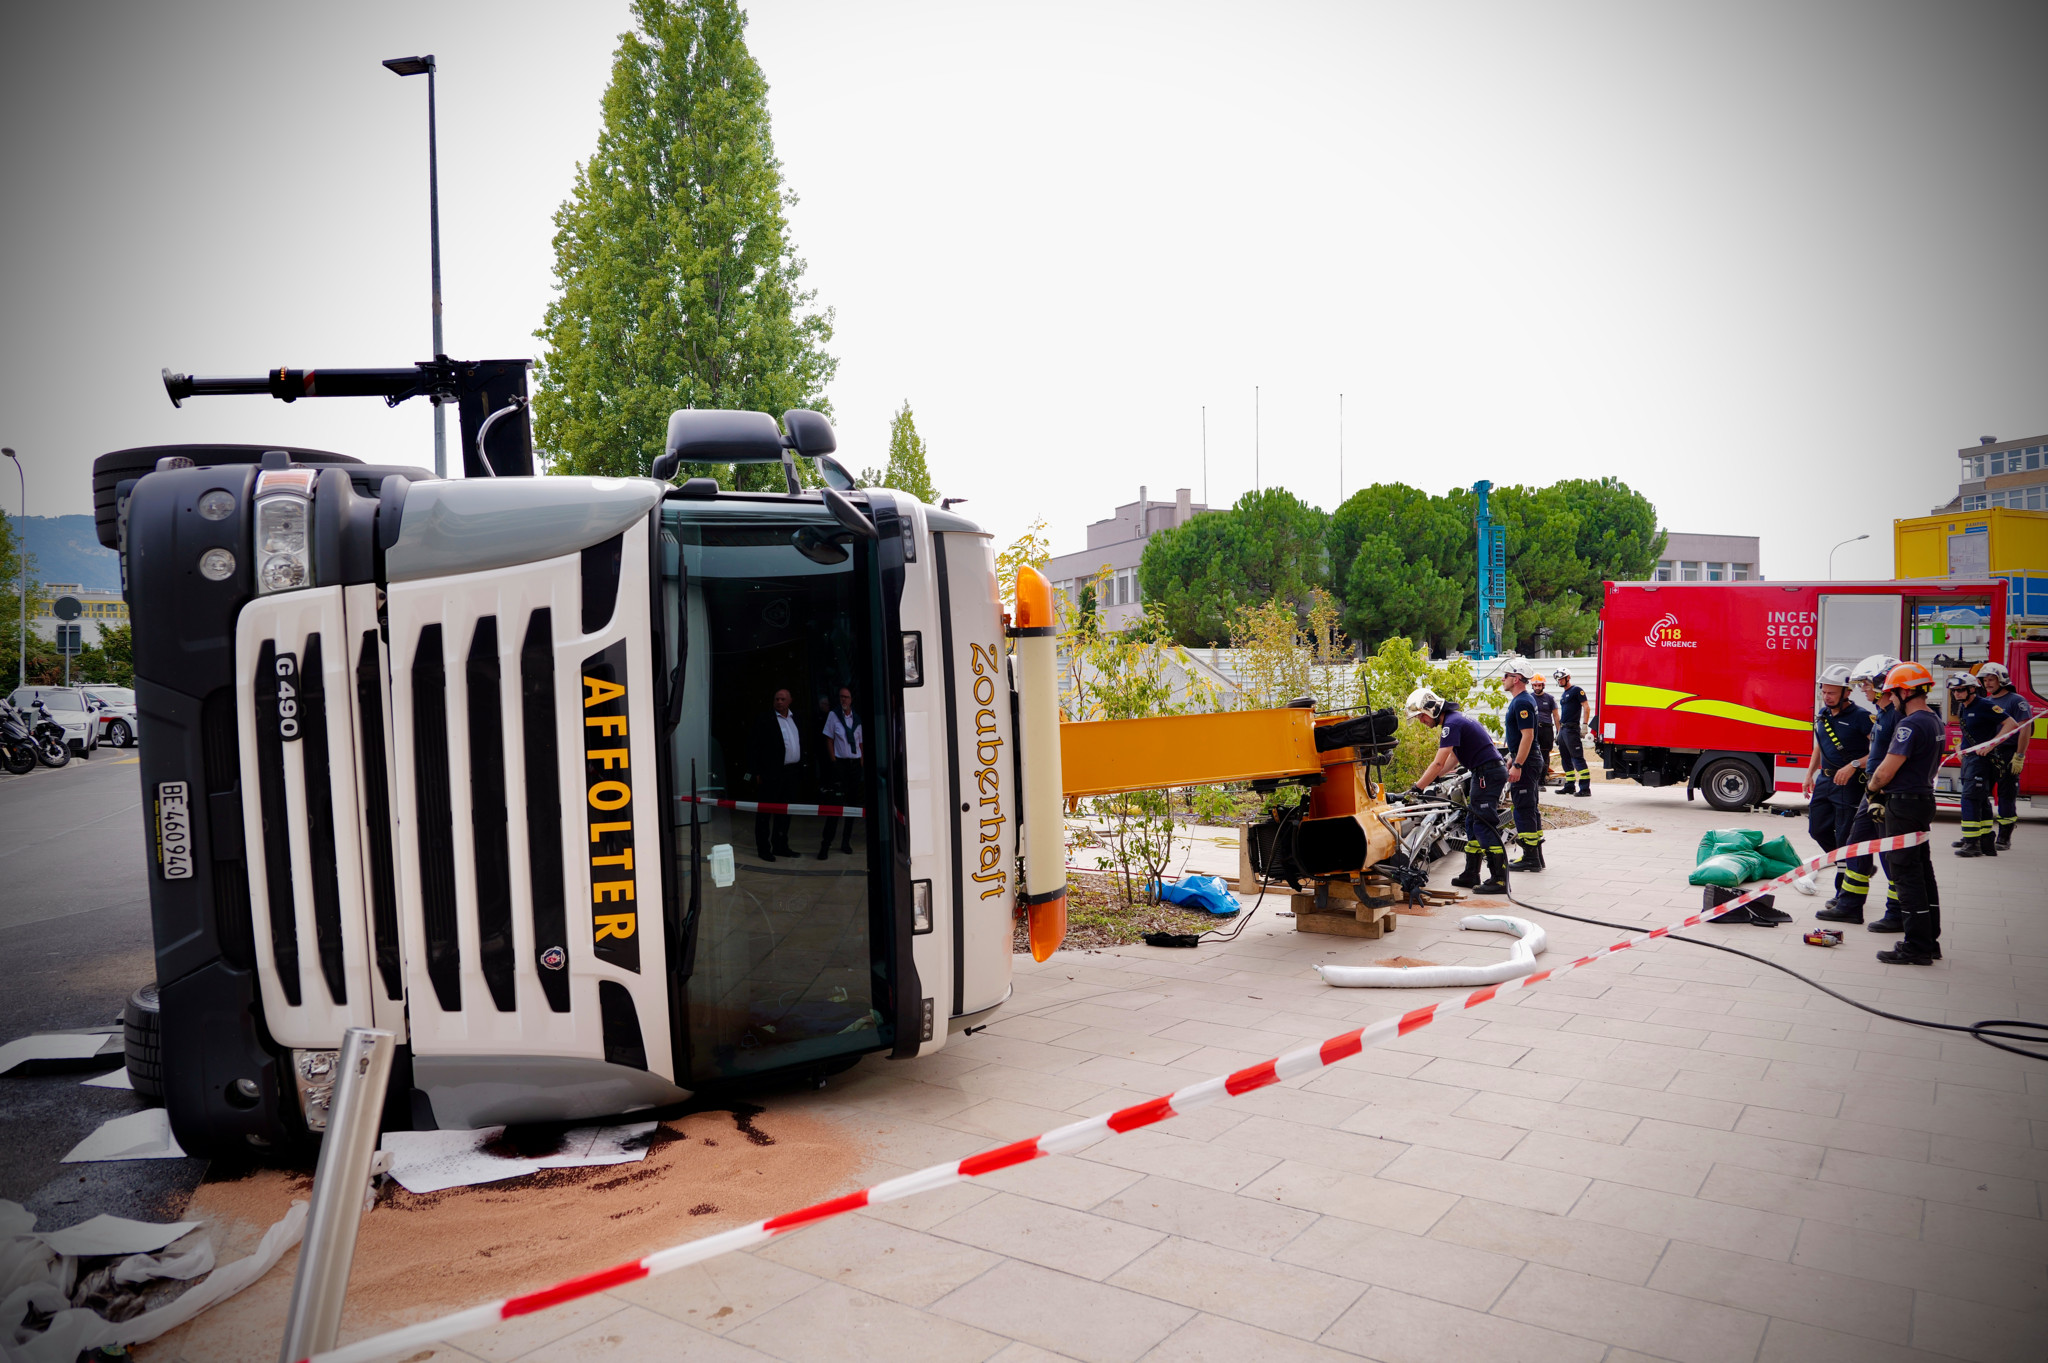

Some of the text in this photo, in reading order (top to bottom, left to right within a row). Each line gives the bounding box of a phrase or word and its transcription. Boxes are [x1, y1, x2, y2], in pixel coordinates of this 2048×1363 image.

[1659, 628, 1682, 640] 118
[1766, 625, 1813, 637] SECO
[275, 657, 298, 737] G 490
[583, 675, 636, 943] AFFOLTER
[970, 642, 1007, 901] Zouberhaft
